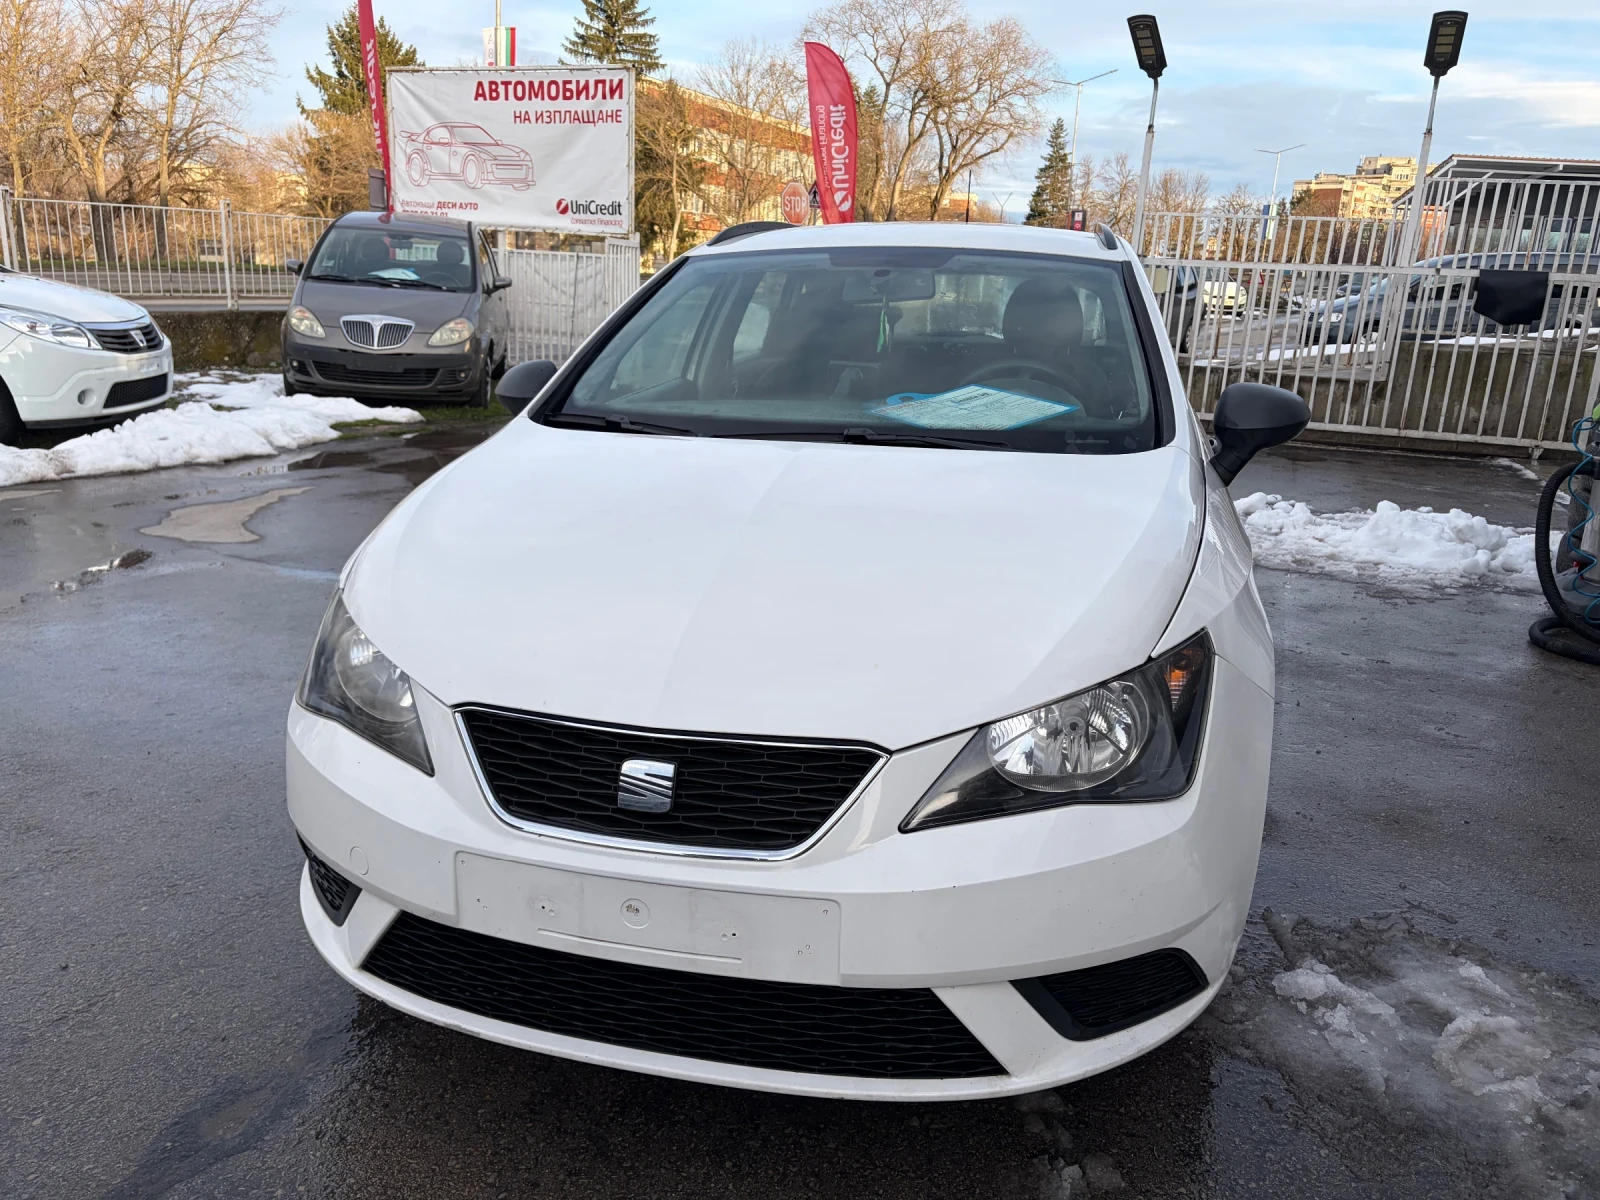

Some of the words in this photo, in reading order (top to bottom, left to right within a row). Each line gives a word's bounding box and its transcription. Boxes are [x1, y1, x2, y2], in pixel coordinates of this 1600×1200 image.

[474, 79, 624, 101] АВТОМОБИЛИ
[513, 110, 531, 124] НА
[535, 109, 623, 127] ИЗПЛАЩАНЕ
[401, 199, 435, 209] Автокъща
[436, 201, 457, 211] ДЕСИ
[458, 202, 479, 211] АУТО
[570, 200, 622, 215] UniCredit
[785, 195, 807, 213] STOP
[571, 217, 596, 226] Consumer
[597, 217, 623, 228] Financing
